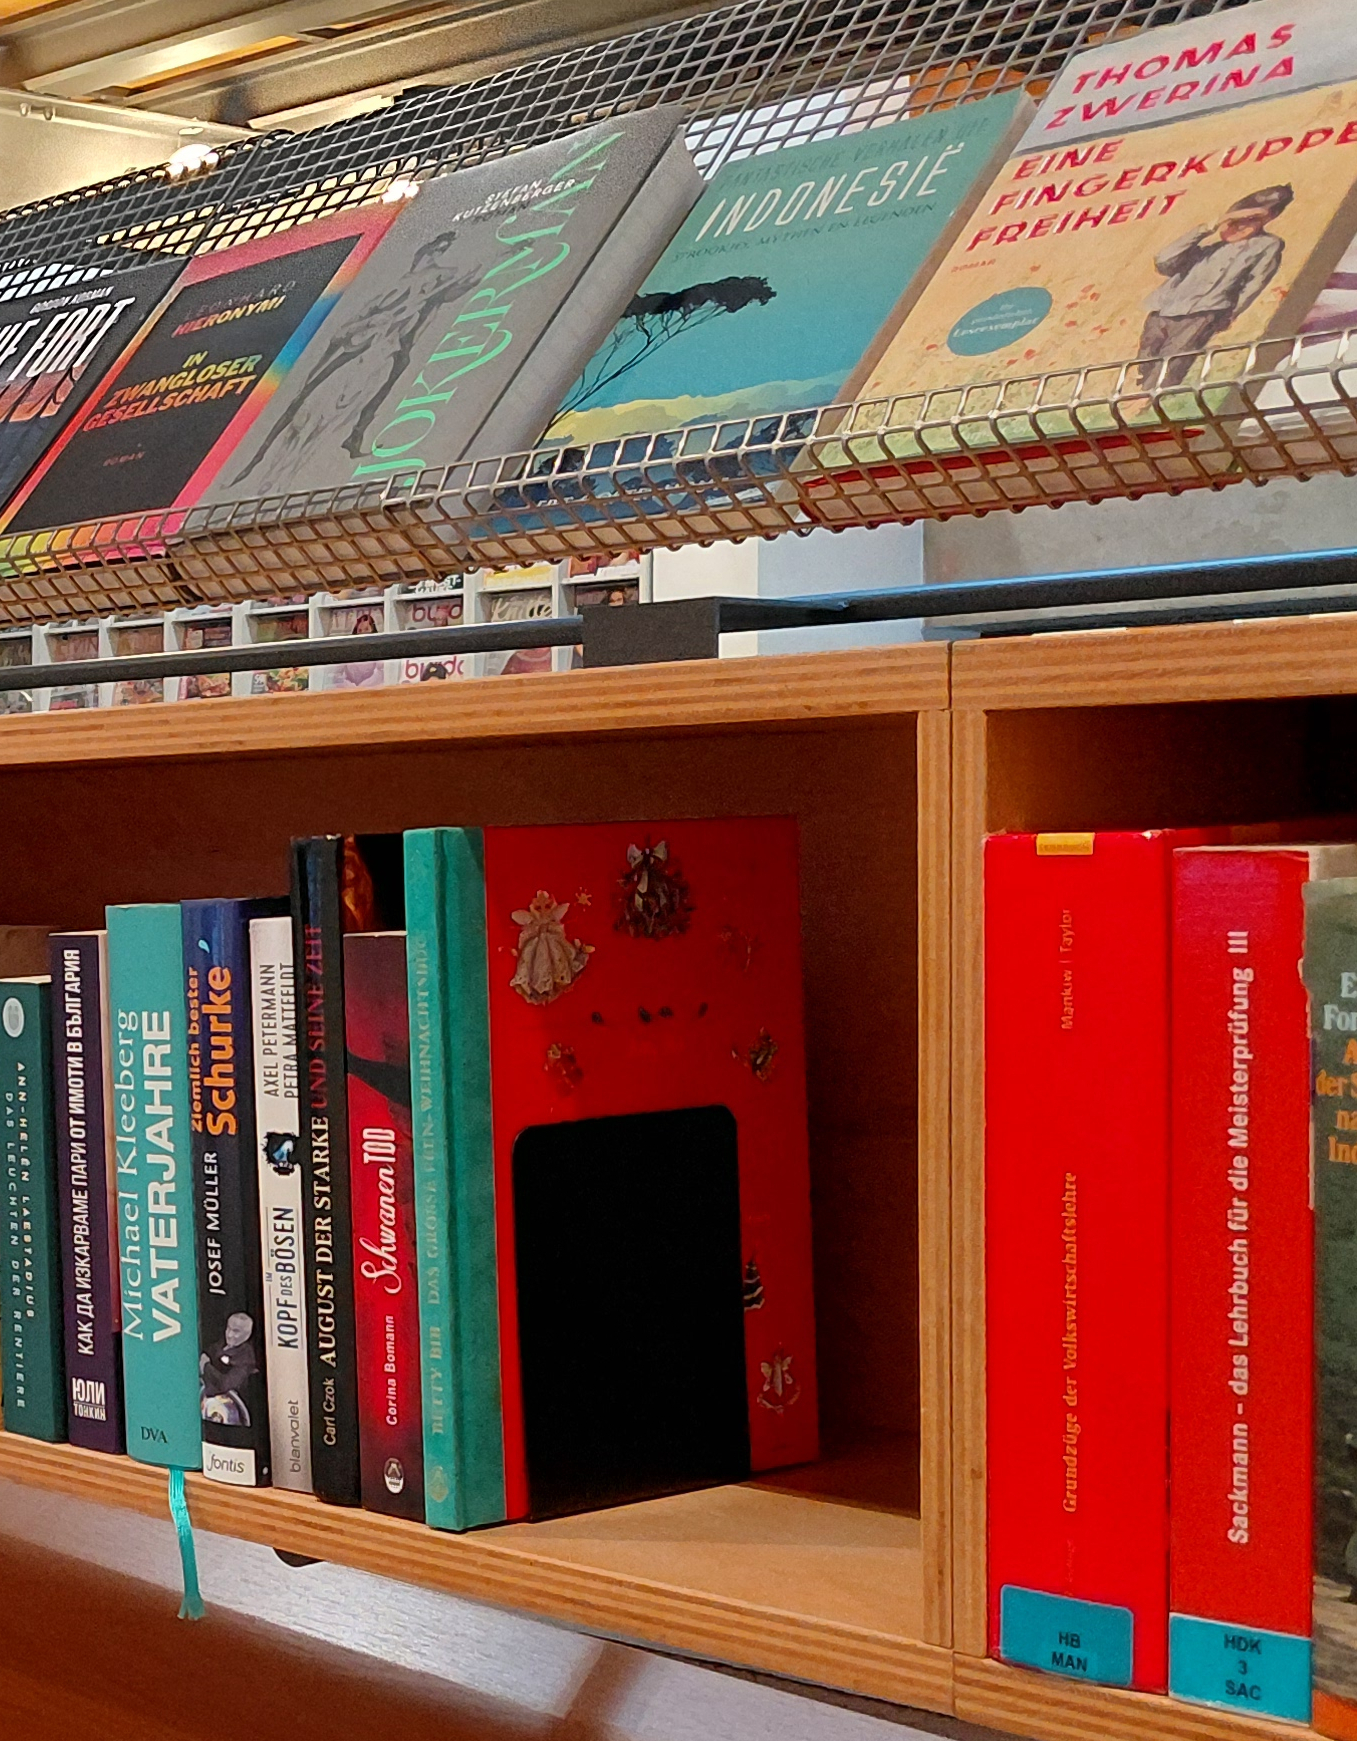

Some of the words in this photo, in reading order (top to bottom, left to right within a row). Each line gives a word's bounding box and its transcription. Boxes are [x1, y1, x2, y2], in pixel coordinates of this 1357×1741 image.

[1071, 23, 1296, 95] THOMAS
[1045, 56, 1295, 131] ZWERINA
[989, 123, 1357, 215] FINGERKUPPE
[1013, 138, 1124, 180] EINE
[452, 178, 577, 222] KUTZENBERGER
[487, 179, 541, 203] STEFAN
[695, 143, 965, 241] INDONESIË
[964, 190, 1189, 252] FREIHEIT
[171, 296, 286, 338] HIERONYMI
[351, 132, 626, 486] JOKERMAN
[7, 297, 135, 381] FORT
[182, 351, 210, 368] IN
[82, 375, 257, 431] GESELLSCHAFT
[103, 354, 263, 409] ZWANGLOSER
[1059, 909, 1076, 954] Taylor
[1227, 930, 1249, 954] III
[63, 948, 83, 1037] БЪЛГАРИЯ
[186, 966, 199, 1034] bester
[260, 962, 277, 1056] PETERMANN
[308, 977, 326, 1058] SEINE
[1061, 968, 1074, 1030] Mankiw
[66, 1038, 84, 1053] В
[204, 964, 238, 1137] Schurke
[1227, 966, 1254, 1149] Meisterprüfung
[67, 1055, 85, 1116] ИМОТИ
[115, 1008, 139, 1176] Kleeberg
[188, 1038, 203, 1134] Ziemlich
[263, 1058, 280, 1097] AXEL
[282, 1053, 297, 1100] PETRA
[310, 1060, 328, 1110] UND
[1315, 1069, 1347, 1097] der
[5, 1092, 14, 1134] DAS
[16, 1061, 30, 1181] ANN-HELÉN
[69, 1117, 86, 1139] ОТ
[70, 1141, 87, 1188] ПАРИ
[142, 1010, 182, 1343] VATERJAHRE
[203, 1150, 219, 1232] MÜLLER
[311, 1114, 331, 1213] STARKE
[1227, 1155, 1249, 1192] die
[6, 1141, 19, 1247] LEUCHTEN
[1227, 1196, 1249, 1232] für
[21, 1194, 36, 1318] LAESTADIUS
[71, 1189, 93, 1292] ИЗКАРВАМЕ
[118, 1189, 144, 1340] Michael
[207, 1237, 226, 1296] JOSEF
[271, 1206, 296, 1273] BÖSEN
[316, 1217, 333, 1264] DER
[11, 1259, 21, 1297] DER
[284, 1274, 294, 1296] DES
[1061, 1172, 1079, 1371] Volkswirtschaftslehre
[1227, 1237, 1249, 1347] Lehrbuch
[76, 1292, 94, 1318] ДА
[276, 1297, 299, 1352] KOPF
[318, 1269, 337, 1368] AUGUST
[12, 1309, 26, 1409] RENTIERE
[77, 1319, 95, 1355] КАК
[383, 1313, 396, 1375] Bomann
[322, 1375, 335, 1409] Czok
[384, 1377, 398, 1427] Corina
[1064, 1374, 1079, 1408] der
[1227, 1353, 1249, 1396] das
[140, 1426, 168, 1445] DVA
[288, 1399, 301, 1474] blanvalet
[323, 1411, 336, 1446] Carl
[207, 1454, 248, 1477] fontis
[1062, 1411, 1081, 1514] Grundzüge
[1227, 1423, 1249, 1545] Sackmann
[1051, 1650, 1088, 1673] MAN
[1058, 1631, 1082, 1650] HB
[1223, 1634, 1262, 1656] HDK
[1237, 1658, 1248, 1676] 3
[1225, 1679, 1262, 1701] SAC
